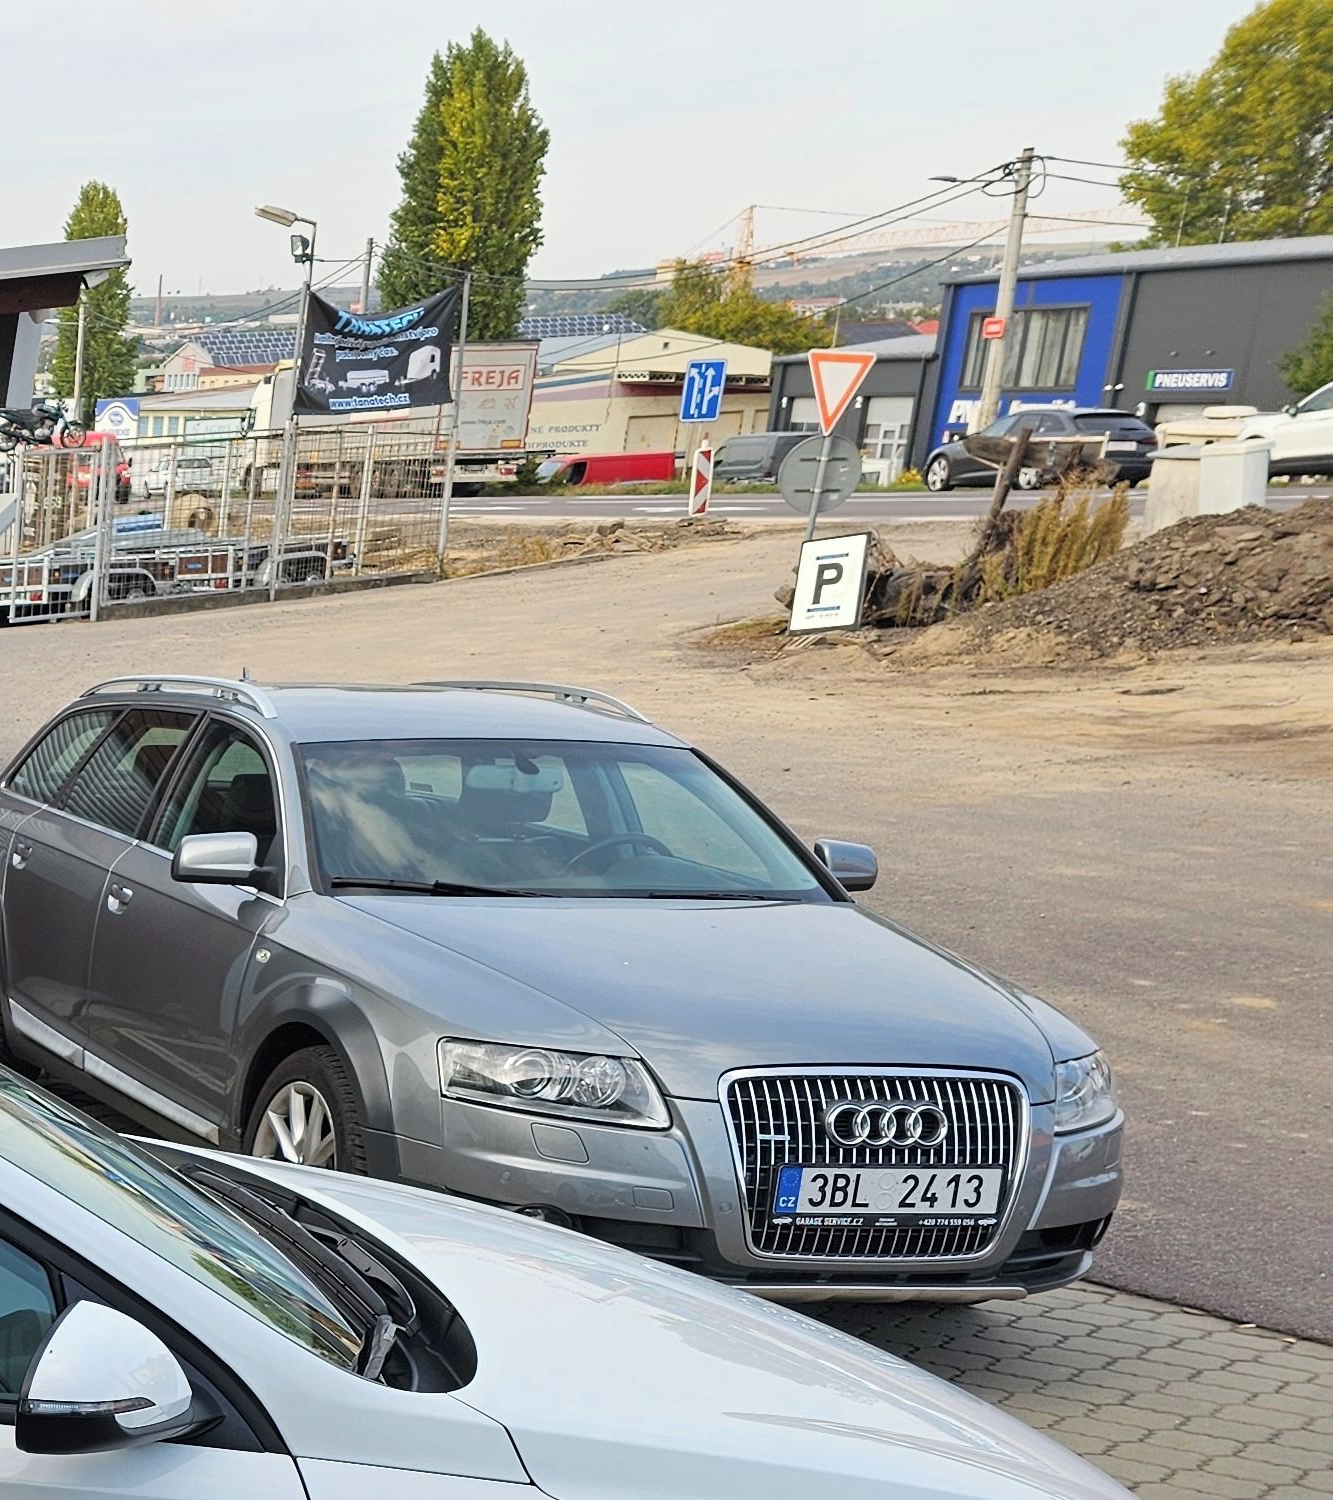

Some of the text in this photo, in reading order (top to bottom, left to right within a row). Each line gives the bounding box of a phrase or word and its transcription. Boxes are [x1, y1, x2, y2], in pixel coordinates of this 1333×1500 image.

[461, 369, 520, 388] FREJA
[1154, 373, 1228, 388] PNEUSERVIS
[329, 393, 410, 409] www.tanatech.cz
[781, 396, 788, 408] 1
[854, 395, 862, 409] 2
[1135, 401, 1146, 416] 3
[548, 424, 602, 433] PRODUKTY
[812, 562, 844, 605] P
[779, 1173, 984, 1208] CZ 3BL 2413
[796, 1217, 864, 1225] GARAGE SERVICE.CZ
